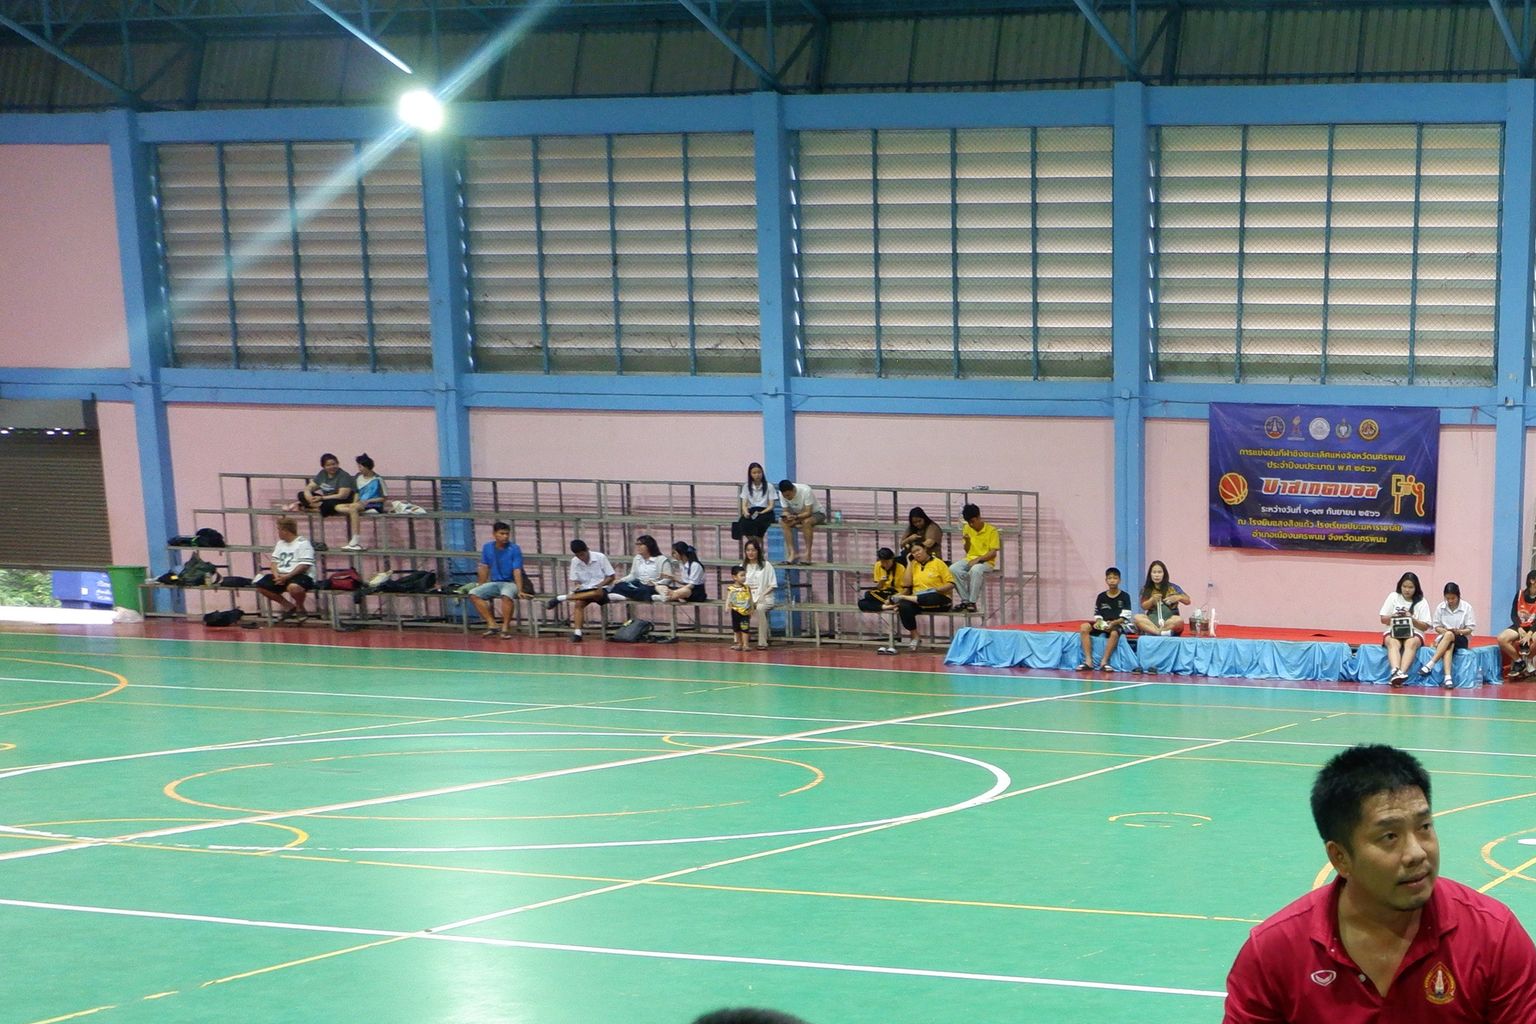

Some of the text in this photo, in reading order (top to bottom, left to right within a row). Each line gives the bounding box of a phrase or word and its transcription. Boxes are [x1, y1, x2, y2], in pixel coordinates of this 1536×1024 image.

[1260, 477, 1382, 499] บาสเกตบอล
[1326, 507, 1356, 516] กันยายน
